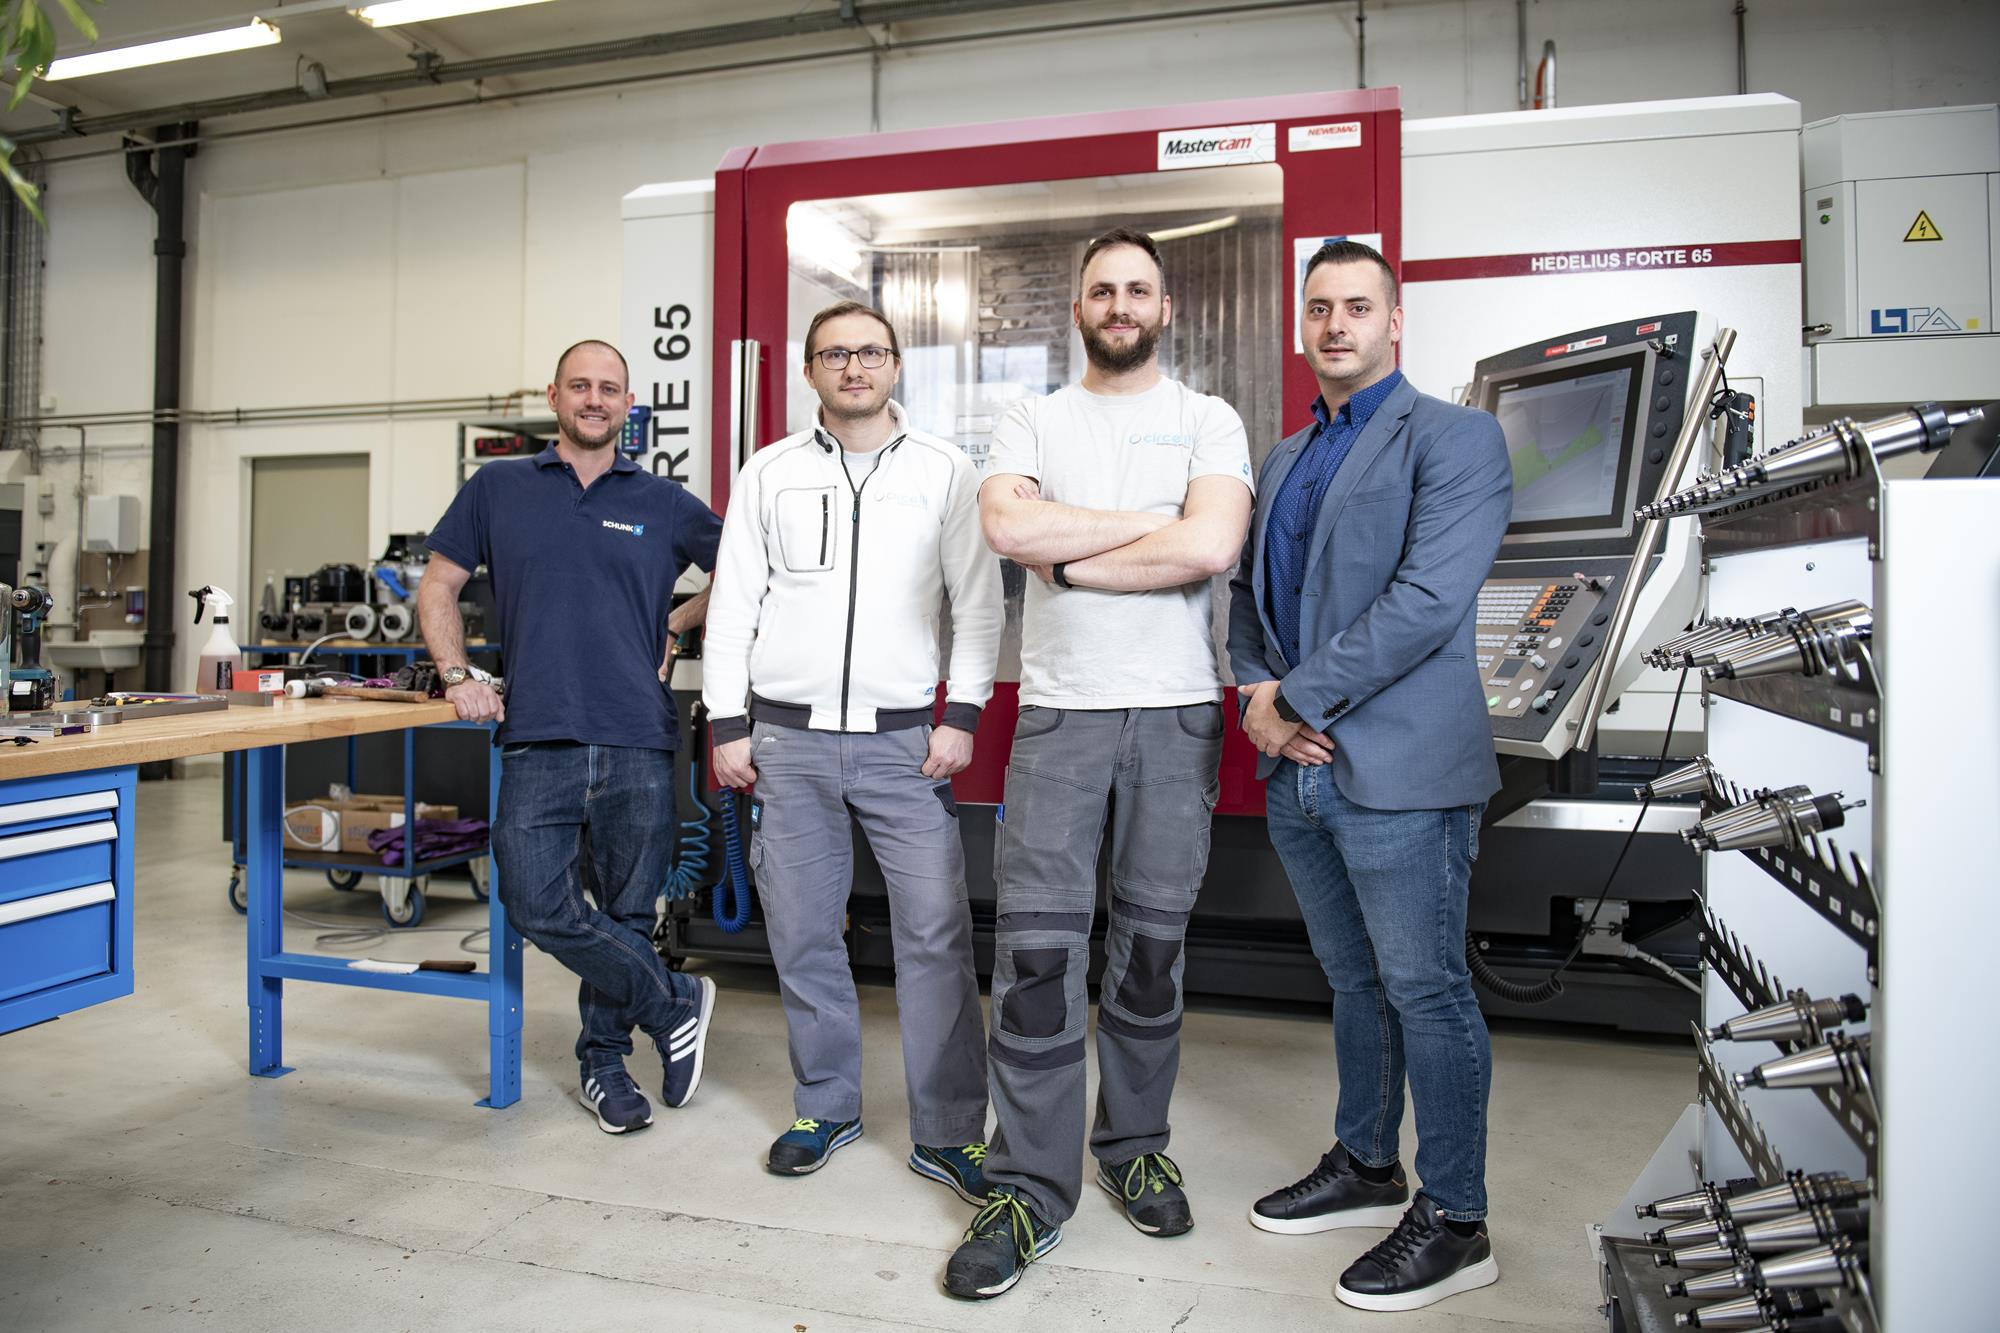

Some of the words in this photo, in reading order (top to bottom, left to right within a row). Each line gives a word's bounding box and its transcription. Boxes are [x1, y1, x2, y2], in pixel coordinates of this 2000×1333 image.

[1307, 124, 1358, 137] NEWEMAG
[1164, 136, 1252, 156] Mastercam
[1531, 253, 1621, 272] HEDELIUS
[1626, 250, 1687, 267] FORTE
[1691, 248, 1713, 264] 65
[653, 303, 692, 361] 65
[1871, 307, 1962, 334] LTA
[652, 380, 690, 484] RTE
[602, 520, 634, 533] SCHUNK
